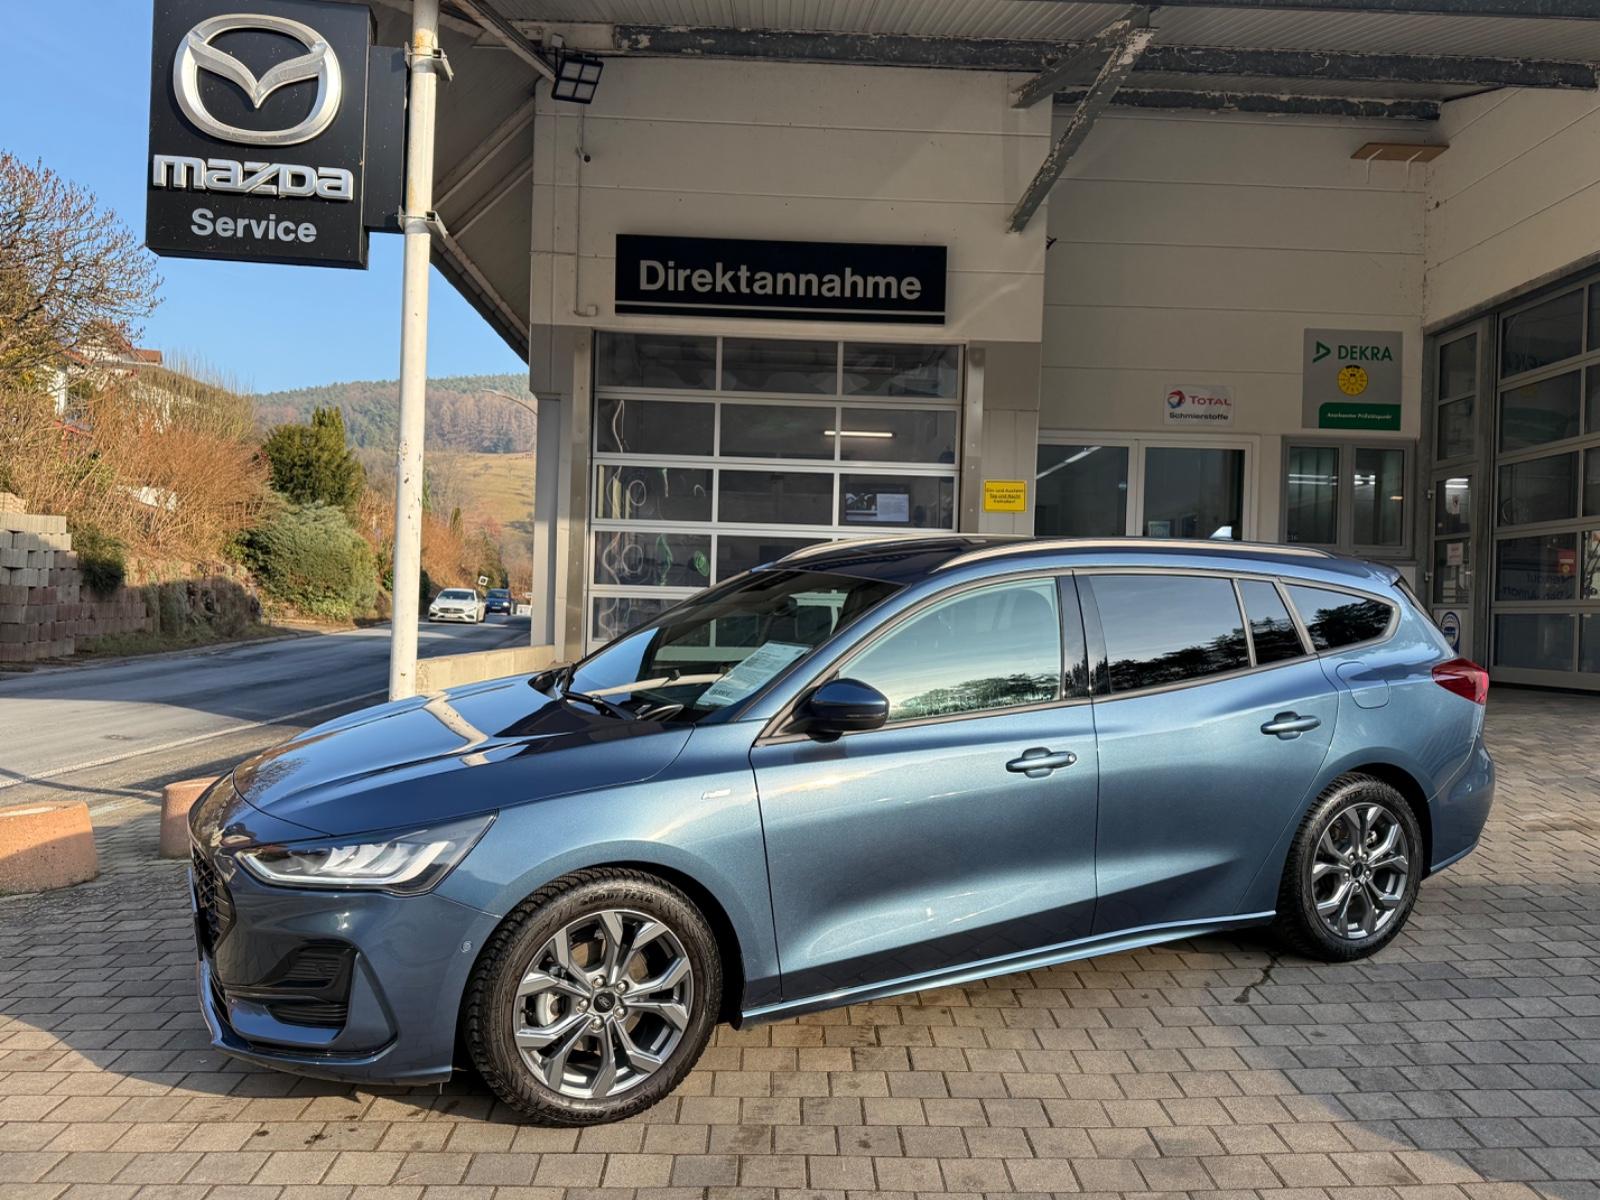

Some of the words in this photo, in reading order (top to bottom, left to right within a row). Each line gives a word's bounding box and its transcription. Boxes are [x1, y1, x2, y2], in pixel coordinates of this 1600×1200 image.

[191, 208, 318, 243] Service
[639, 259, 922, 300] Direktannahme
[1337, 345, 1393, 361] DEKRA
[1188, 395, 1232, 407] TOTAL
[1169, 412, 1229, 421] Schmierstoffe
